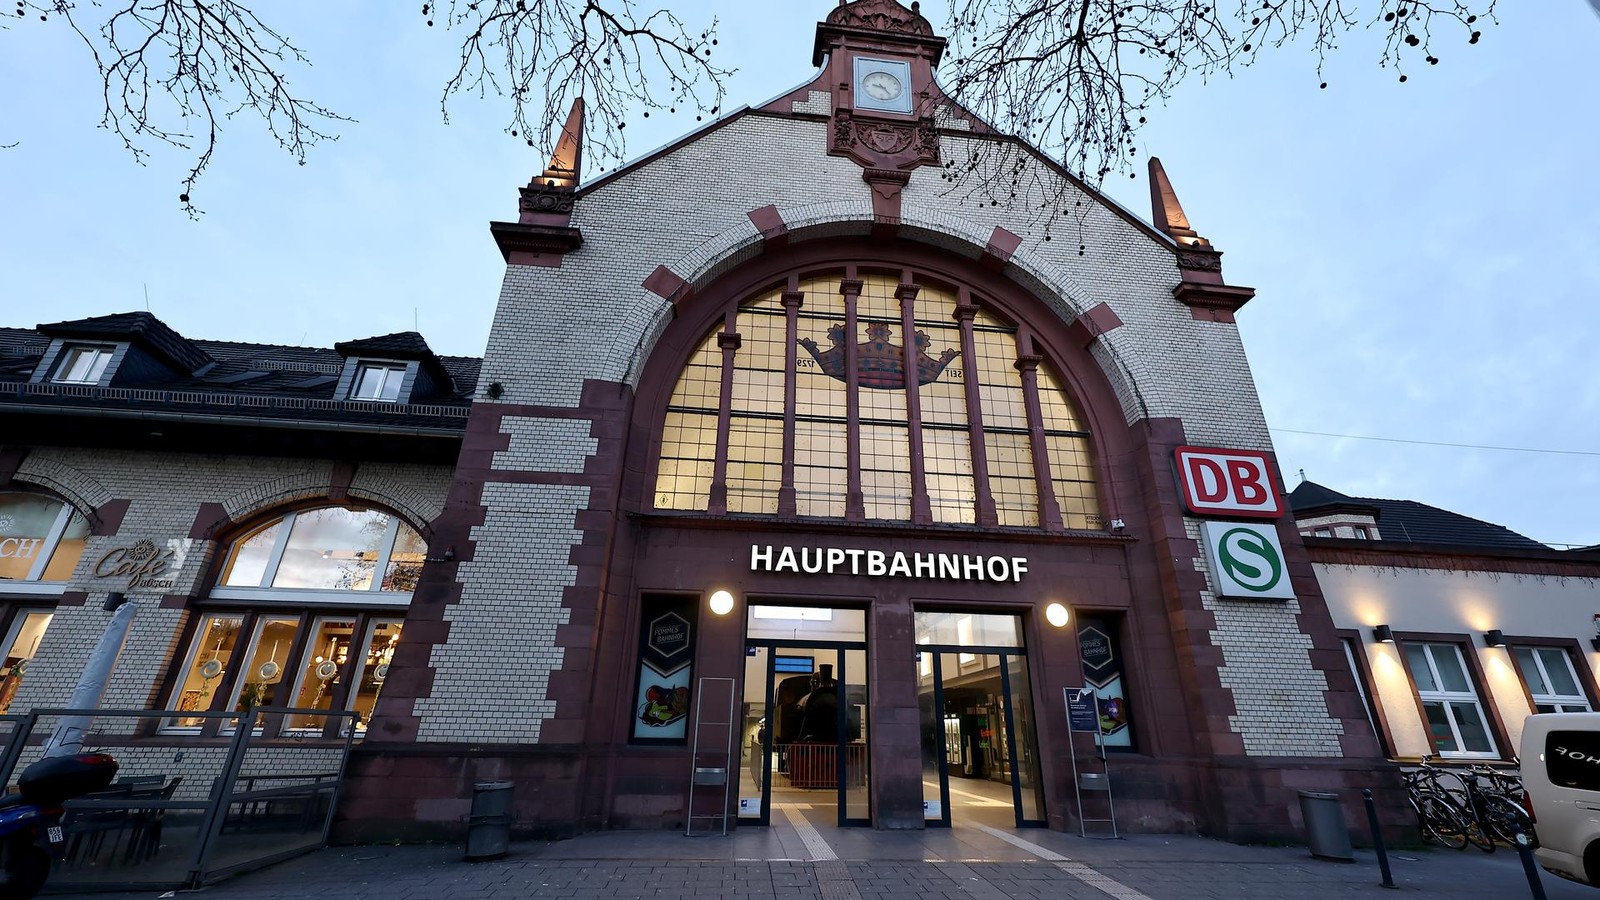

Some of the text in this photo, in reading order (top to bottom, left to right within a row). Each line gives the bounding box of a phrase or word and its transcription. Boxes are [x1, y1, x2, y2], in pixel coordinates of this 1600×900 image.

[1188, 457, 1268, 506] DB
[92, 546, 175, 589] Café
[750, 544, 1028, 582] HAUPTBAHNHOF
[1225, 531, 1274, 587] S
